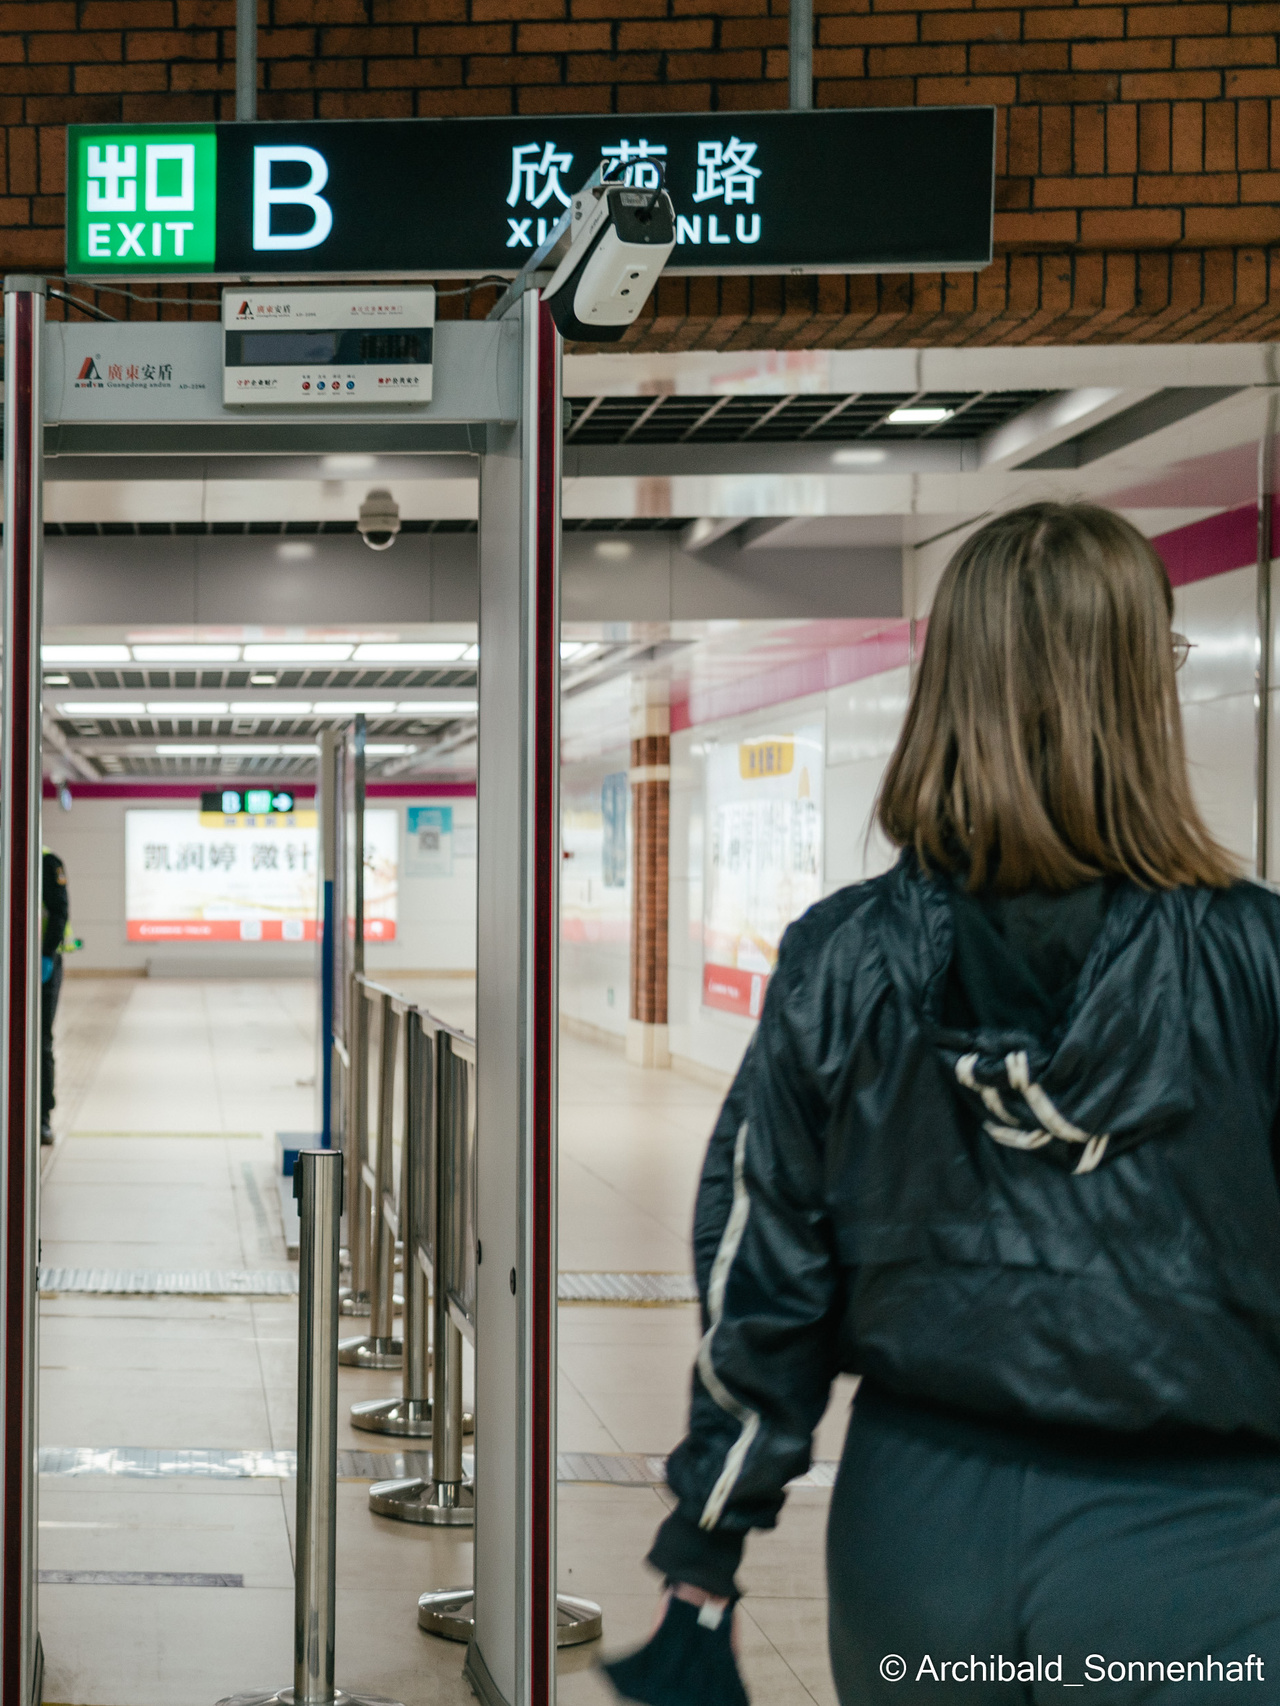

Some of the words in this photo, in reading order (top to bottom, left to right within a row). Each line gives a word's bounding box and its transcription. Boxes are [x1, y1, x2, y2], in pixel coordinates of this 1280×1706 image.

[86, 143, 195, 212] 出口
[252, 144, 334, 251] B
[87, 222, 194, 257] EXIT
[506, 213, 762, 248] XINLU
[107, 363, 174, 381] 廣東安盾
[107, 382, 148, 390] Guangdong
